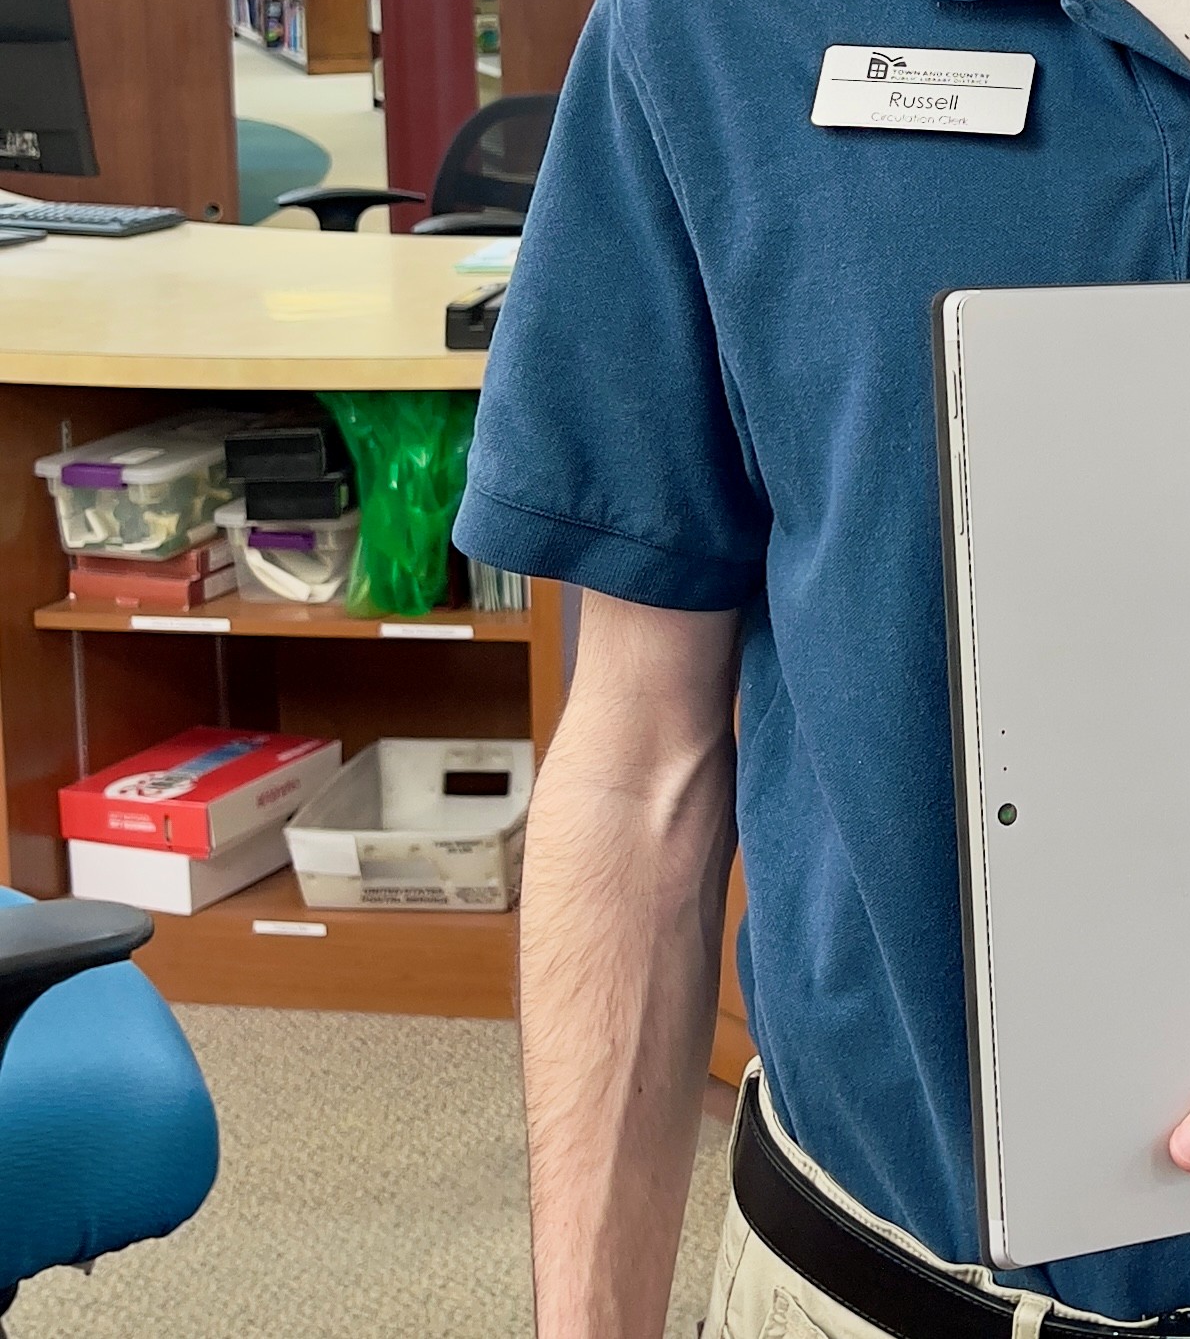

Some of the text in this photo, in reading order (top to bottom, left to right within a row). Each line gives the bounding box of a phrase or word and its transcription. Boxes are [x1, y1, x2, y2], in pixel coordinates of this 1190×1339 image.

[889, 91, 959, 110] Russell
[870, 111, 969, 126] Circulation Clerk
